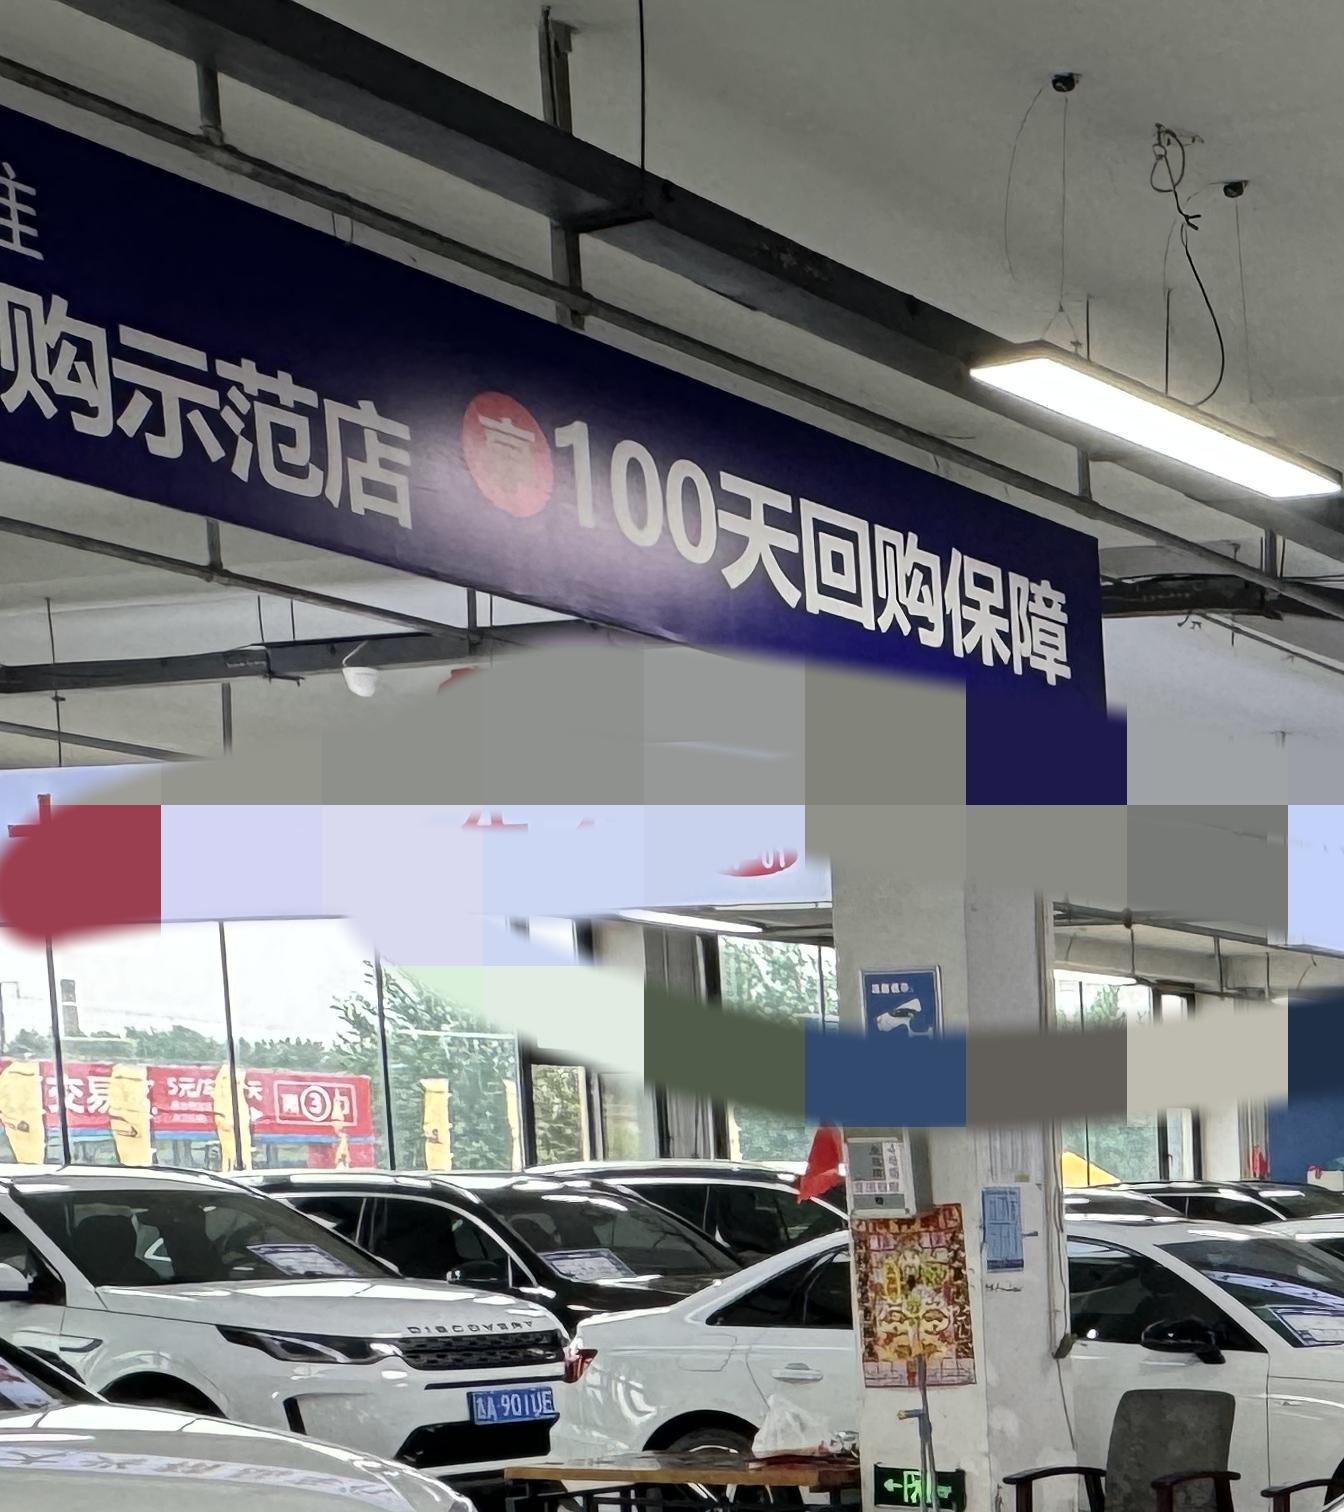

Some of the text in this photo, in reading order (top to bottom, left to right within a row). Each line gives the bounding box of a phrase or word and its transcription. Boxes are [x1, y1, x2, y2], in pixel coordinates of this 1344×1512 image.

[0, 282, 413, 530] 购示范店
[554, 420, 1072, 685] 100天回购保障
[407, 1321, 533, 1334] DISCOVERY
